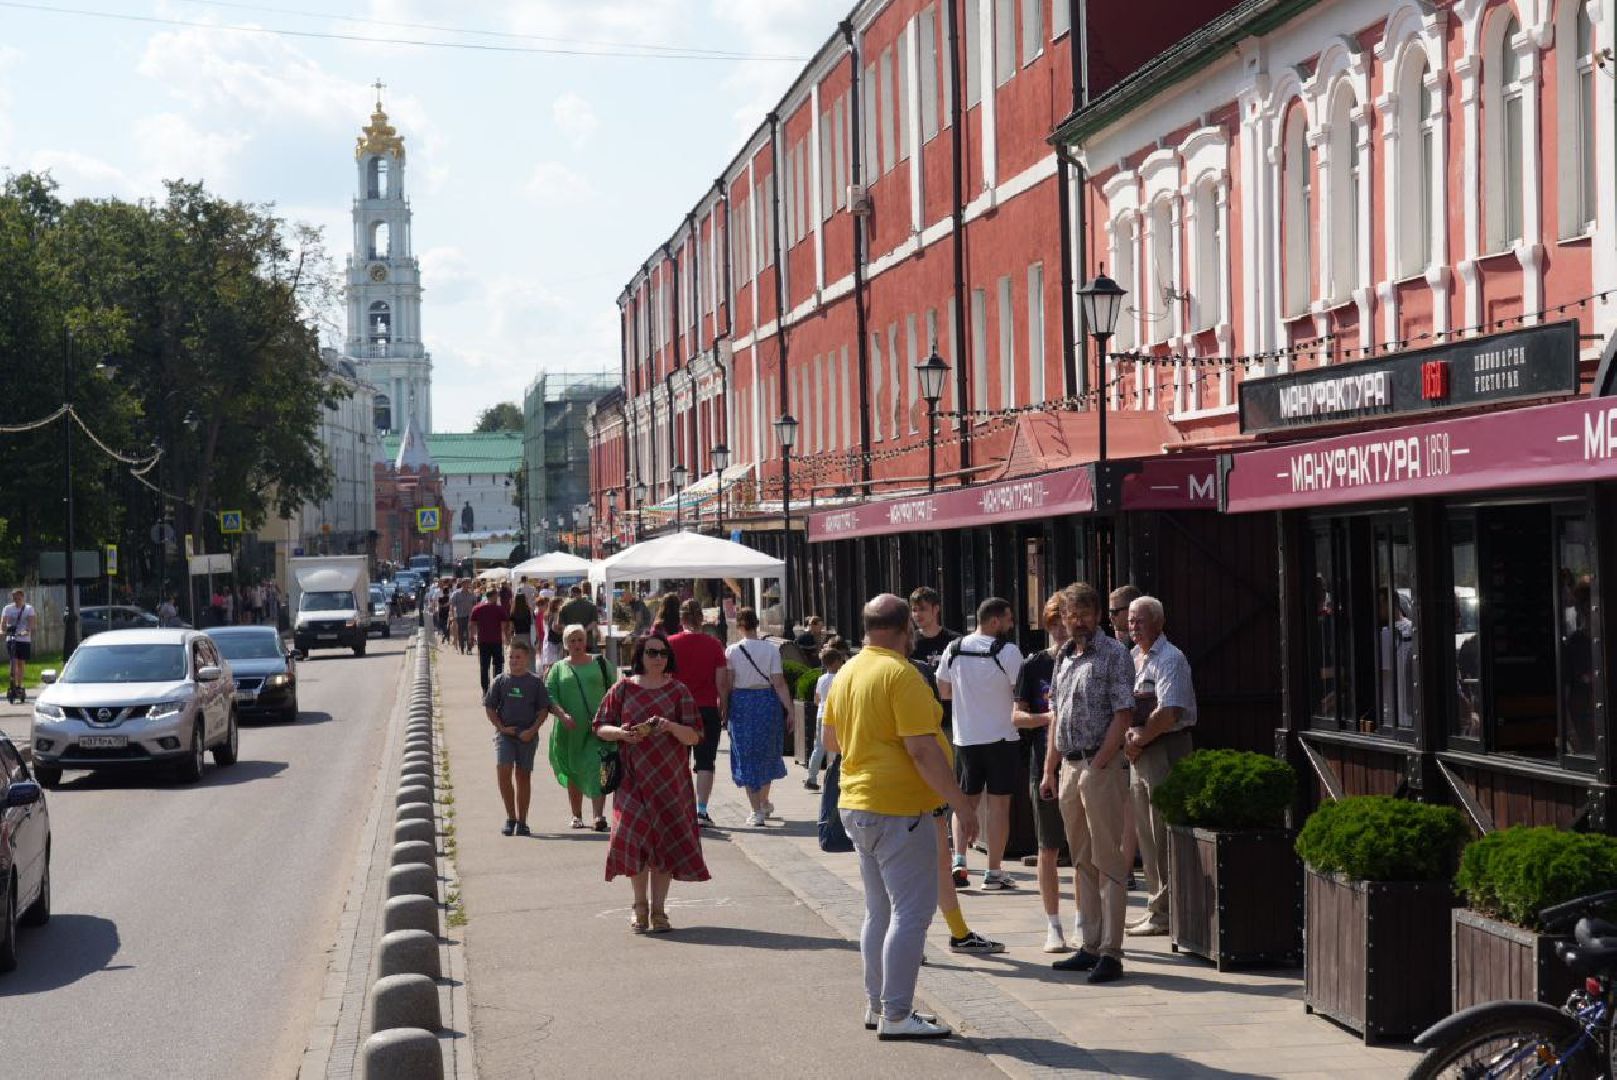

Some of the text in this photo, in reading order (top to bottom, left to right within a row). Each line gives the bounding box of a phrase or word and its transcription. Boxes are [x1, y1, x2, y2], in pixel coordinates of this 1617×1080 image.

[1280, 371, 1387, 419] МАНУФАКТУРА
[1291, 432, 1450, 492] МАНУФАКТУРА 1858
[1188, 473, 1215, 500] М
